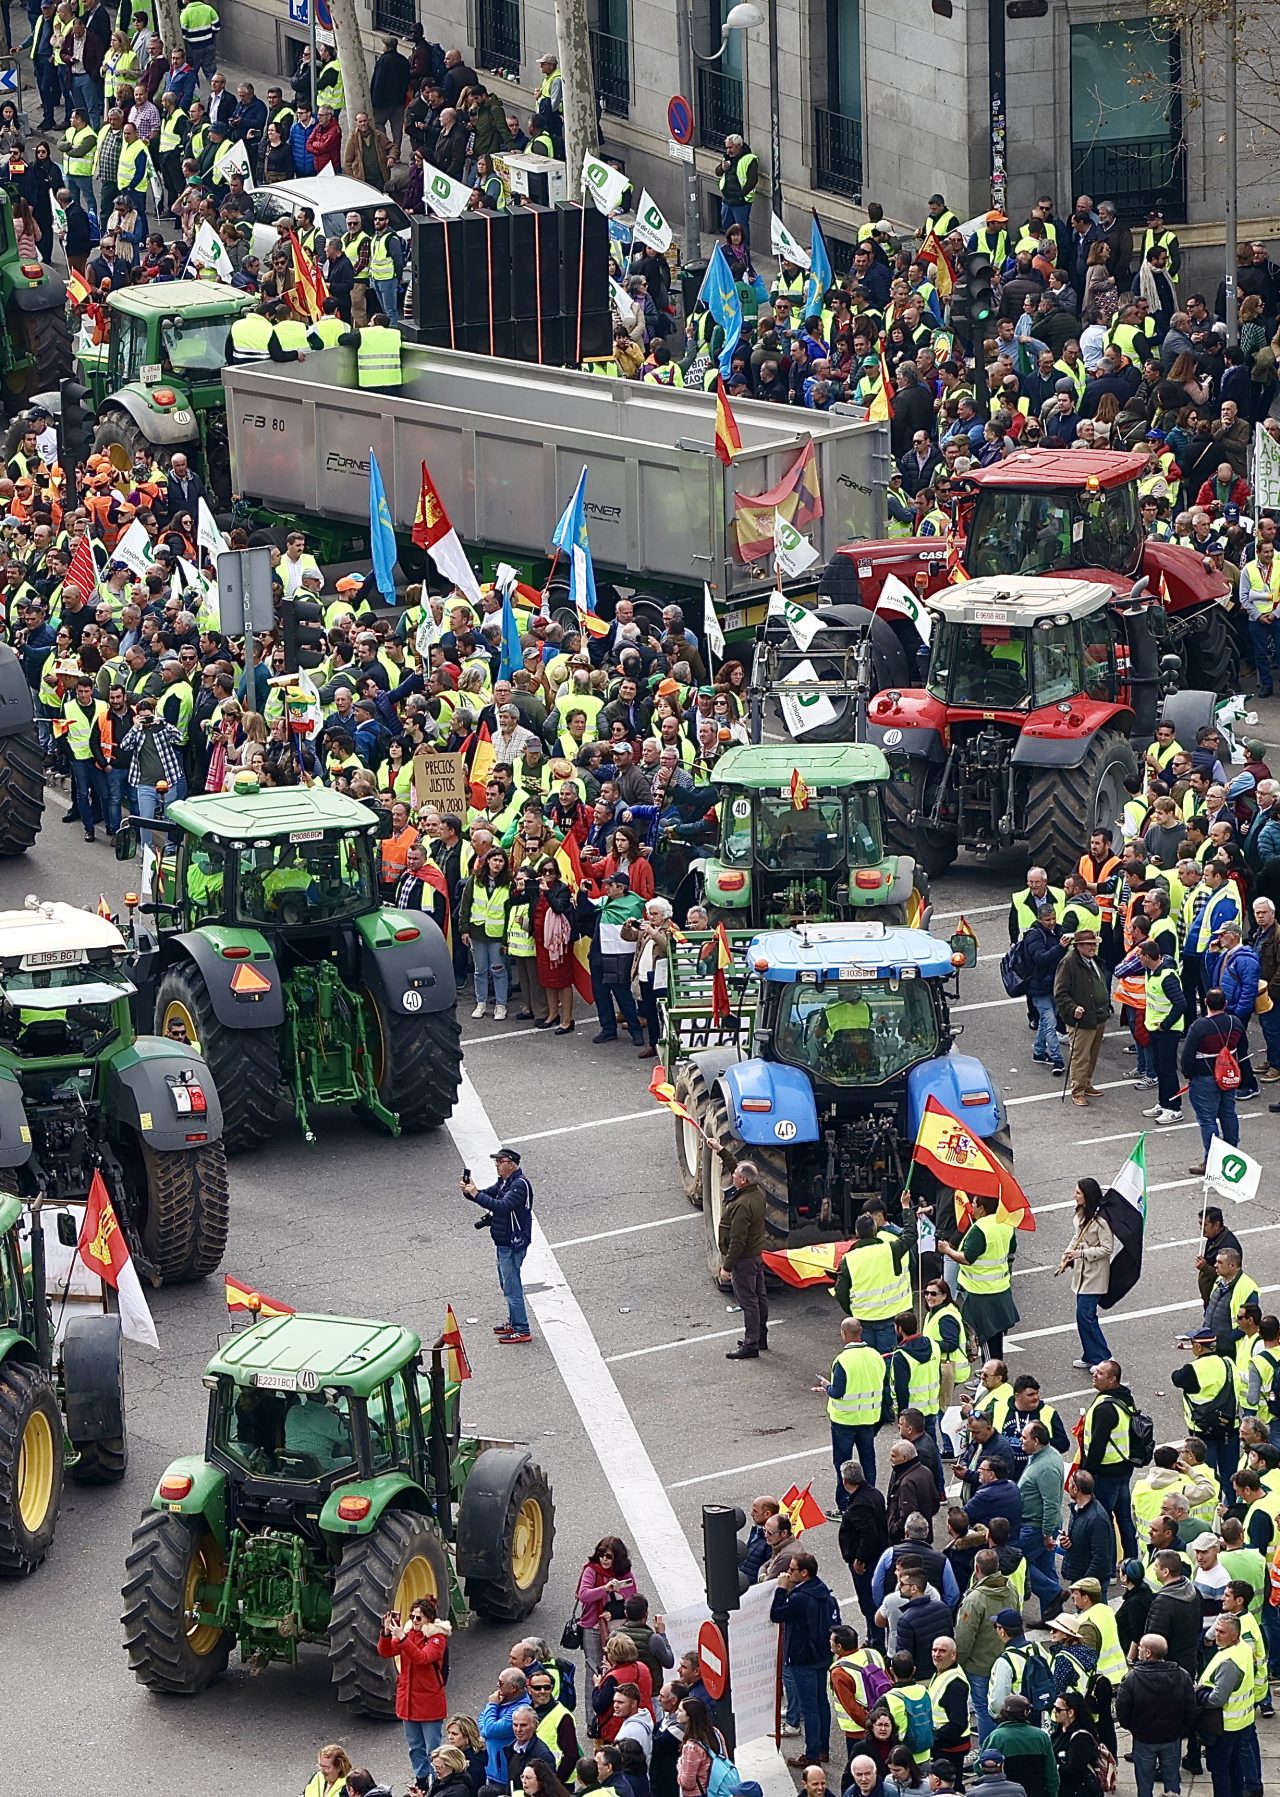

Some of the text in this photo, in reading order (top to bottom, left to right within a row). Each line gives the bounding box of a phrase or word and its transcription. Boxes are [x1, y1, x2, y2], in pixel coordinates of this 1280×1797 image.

[242, 413, 285, 432] FB 80
[326, 452, 371, 471] FORNIE
[886, 730, 899, 743] 40
[424, 759, 456, 776] PRECIOS
[429, 777, 456, 793] JUSTOS
[445, 797, 463, 813] 2030
[735, 802, 747, 816] 40
[40, 952, 58, 961] 1195
[406, 993, 419, 1009] 40
[777, 1123, 794, 1137] 40
[302, 1371, 315, 1389] 40
